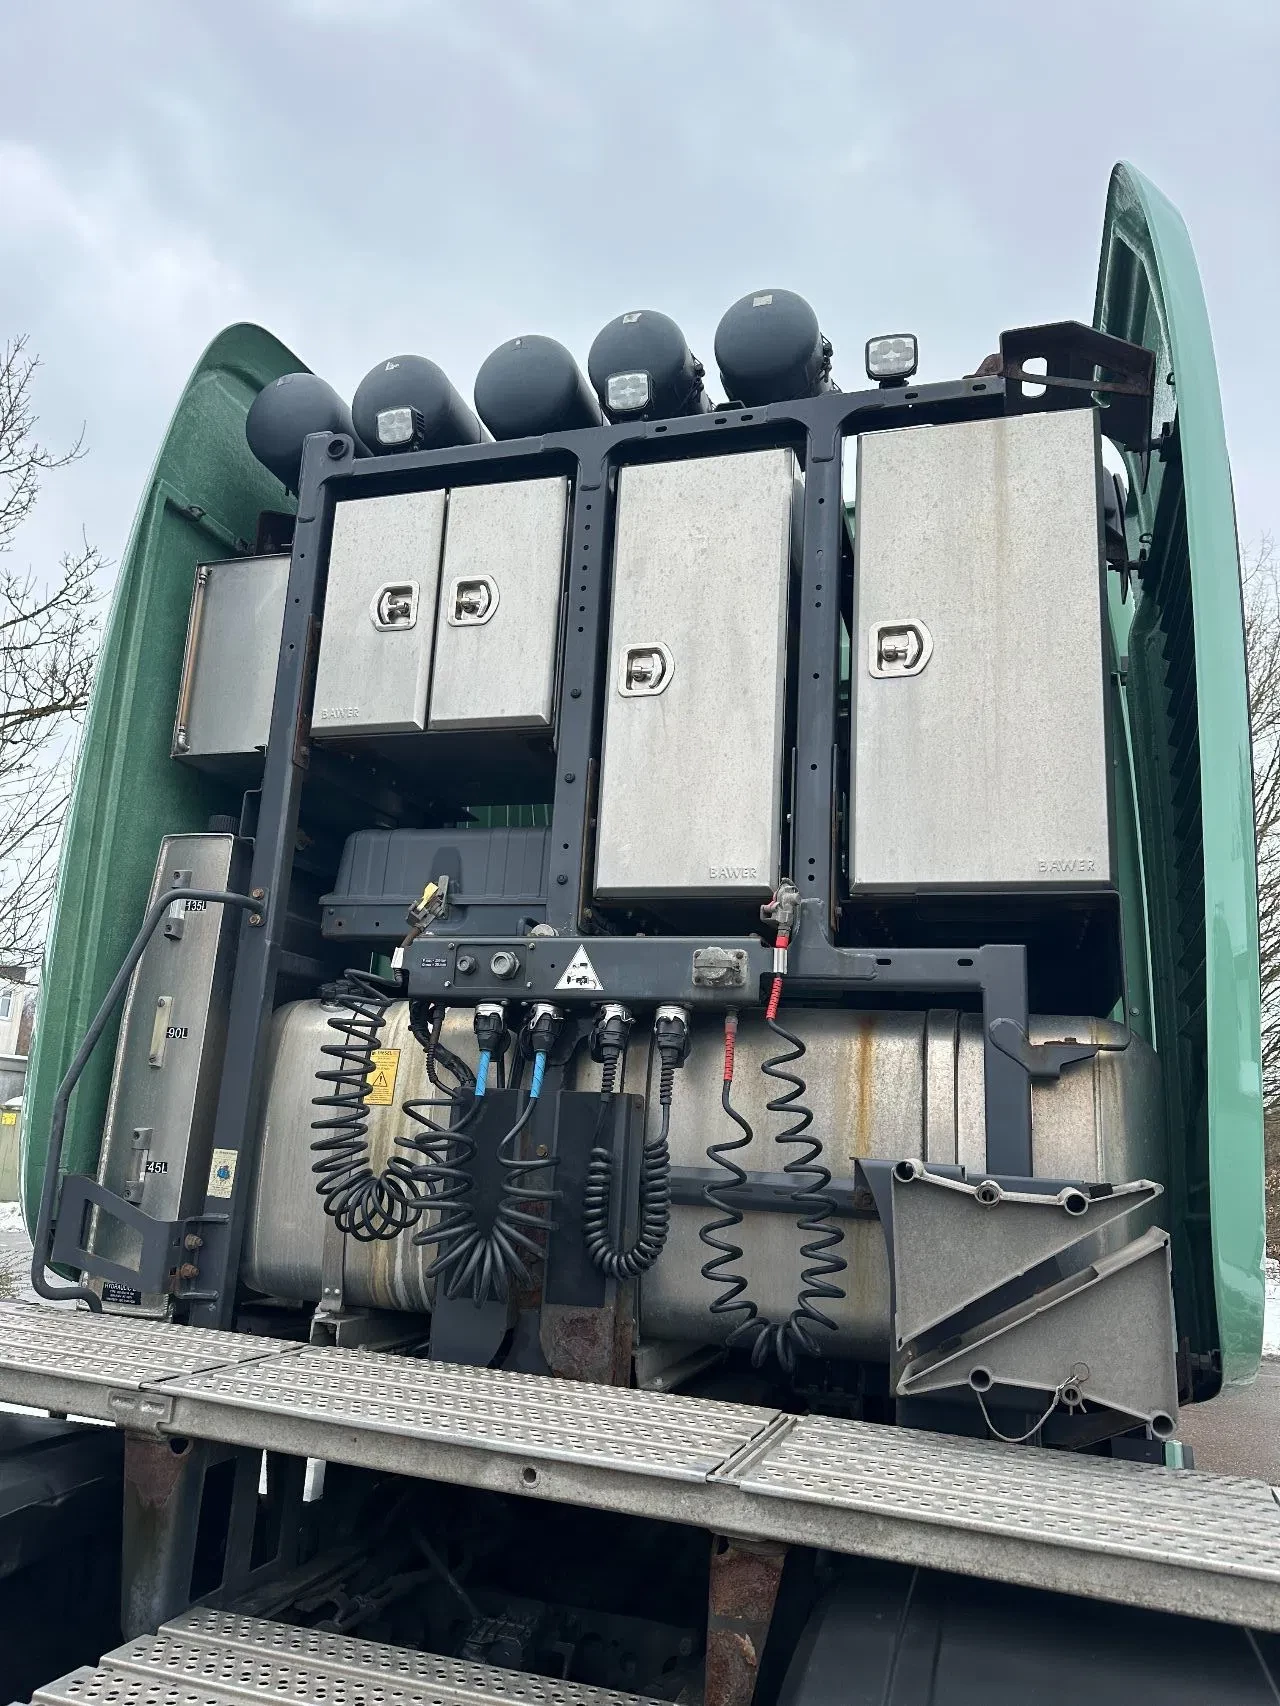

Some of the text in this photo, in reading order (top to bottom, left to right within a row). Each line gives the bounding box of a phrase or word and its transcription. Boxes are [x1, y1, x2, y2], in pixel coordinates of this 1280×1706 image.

[321, 707, 359, 719] BAWER
[1039, 858, 1095, 872] BAWER
[709, 867, 757, 879] BAWER
